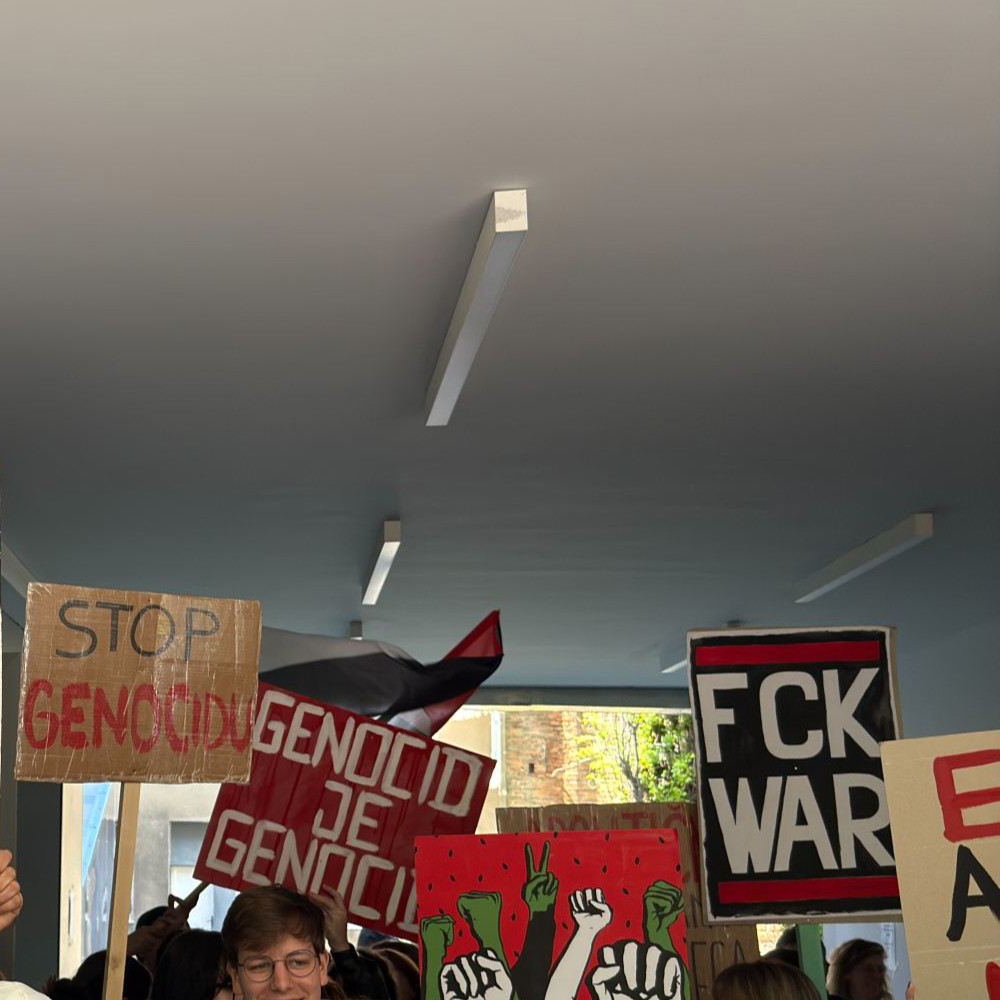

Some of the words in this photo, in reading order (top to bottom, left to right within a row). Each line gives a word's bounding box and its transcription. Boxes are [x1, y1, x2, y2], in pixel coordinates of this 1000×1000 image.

[56, 600, 220, 660] STOP
[24, 679, 252, 754] GENOCIDU
[252, 690, 484, 818] GENOCID
[696, 667, 880, 763] FCK
[311, 780, 394, 853] JE
[708, 773, 895, 874] WAR
